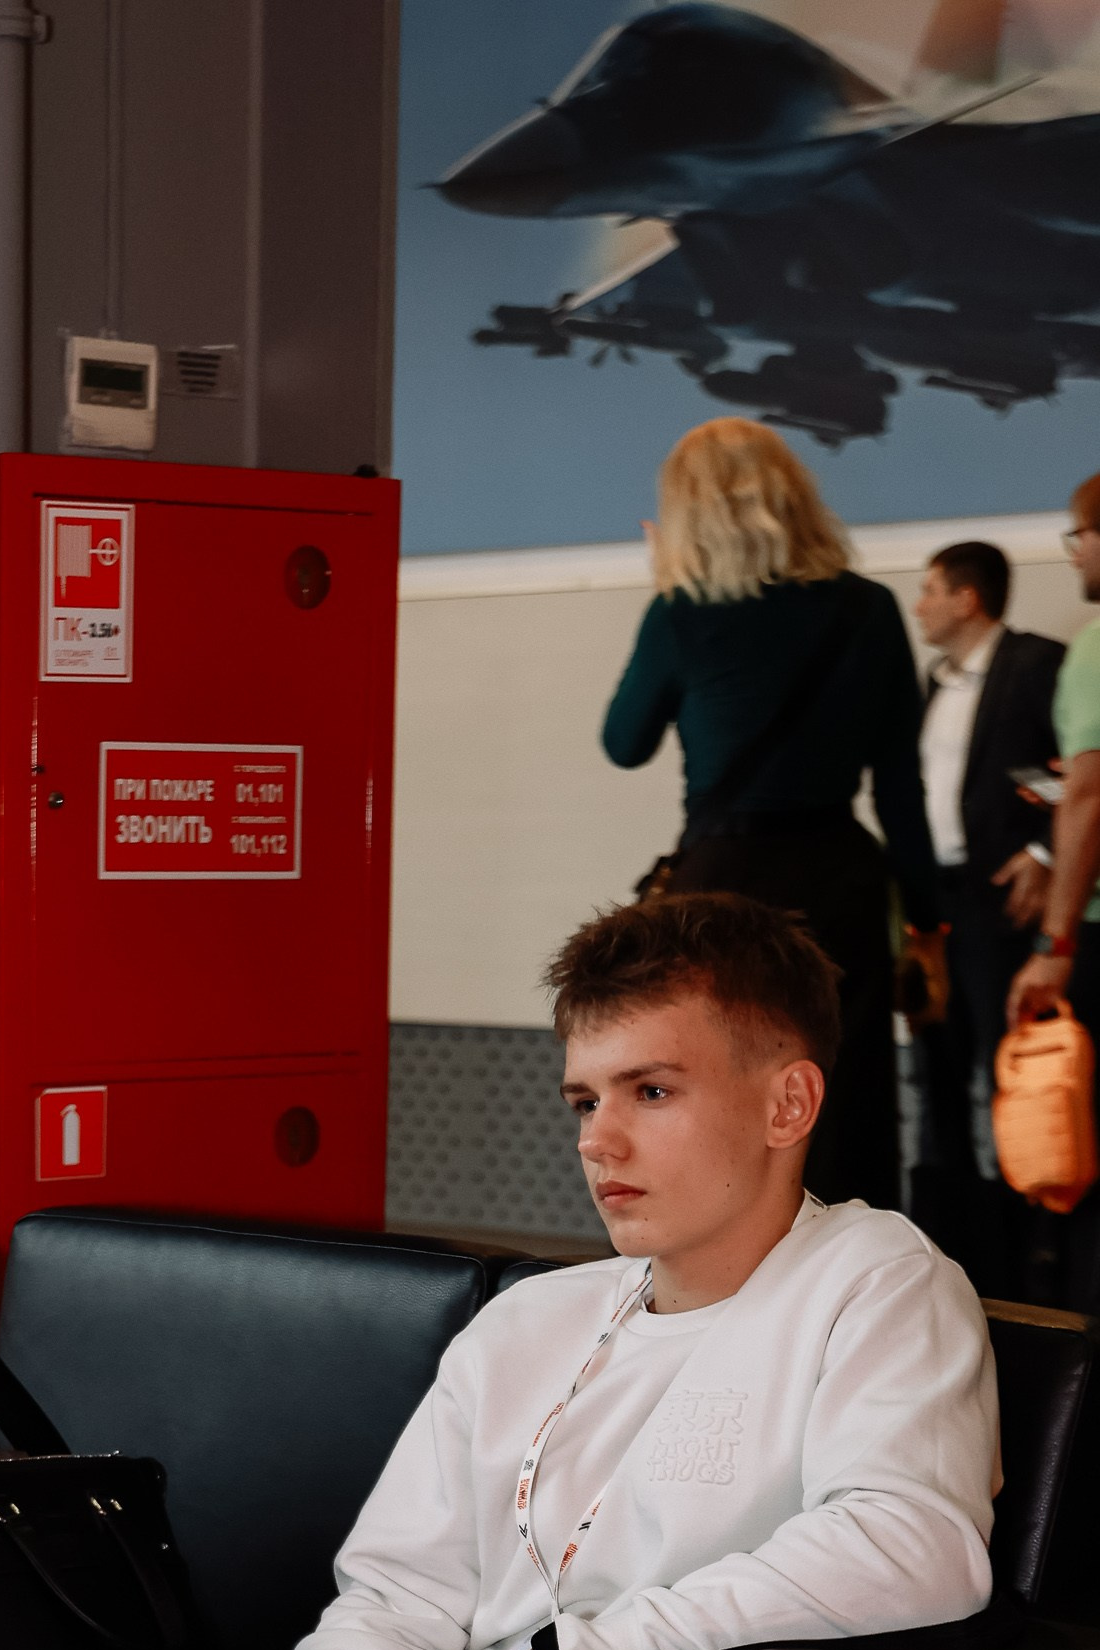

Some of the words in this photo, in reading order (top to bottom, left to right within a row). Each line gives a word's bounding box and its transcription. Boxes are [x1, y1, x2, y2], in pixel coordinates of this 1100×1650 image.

[114, 778, 146, 801] ПРИ
[150, 779, 214, 801] ПОЖАРЕ
[236, 783, 283, 806] 01,101
[115, 815, 213, 844] ЗВОНИТЬ
[230, 835, 287, 857] 101,112
[656, 1387, 748, 1436] 東京
[646, 1459, 736, 1486] THUGS
